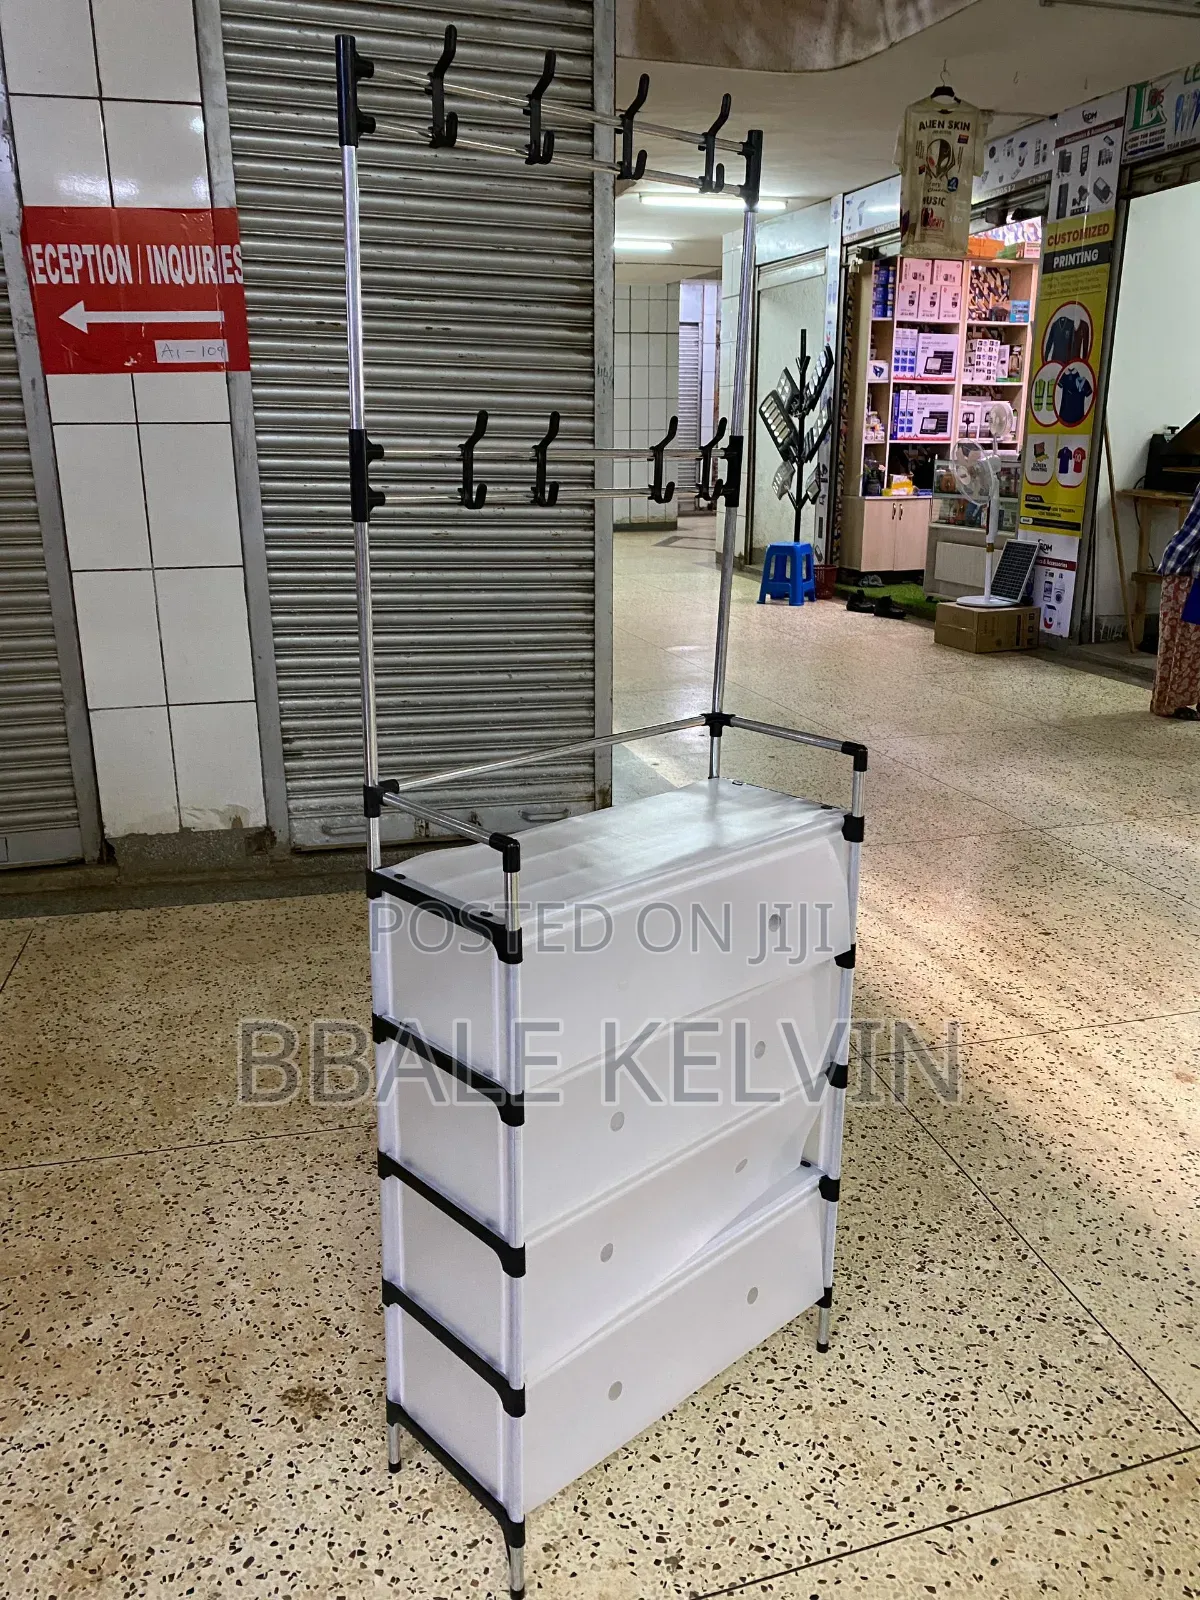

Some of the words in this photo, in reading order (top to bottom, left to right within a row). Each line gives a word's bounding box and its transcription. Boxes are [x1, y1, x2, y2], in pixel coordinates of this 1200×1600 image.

[918, 120, 945, 132] ALIEN
[947, 120, 971, 132] SKIN
[1047, 223, 1110, 247] CUSTOMIZED
[28, 243, 133, 285] ECEPTION
[146, 244, 243, 287] INQUIRIES
[1053, 248, 1099, 269] PRINTING
